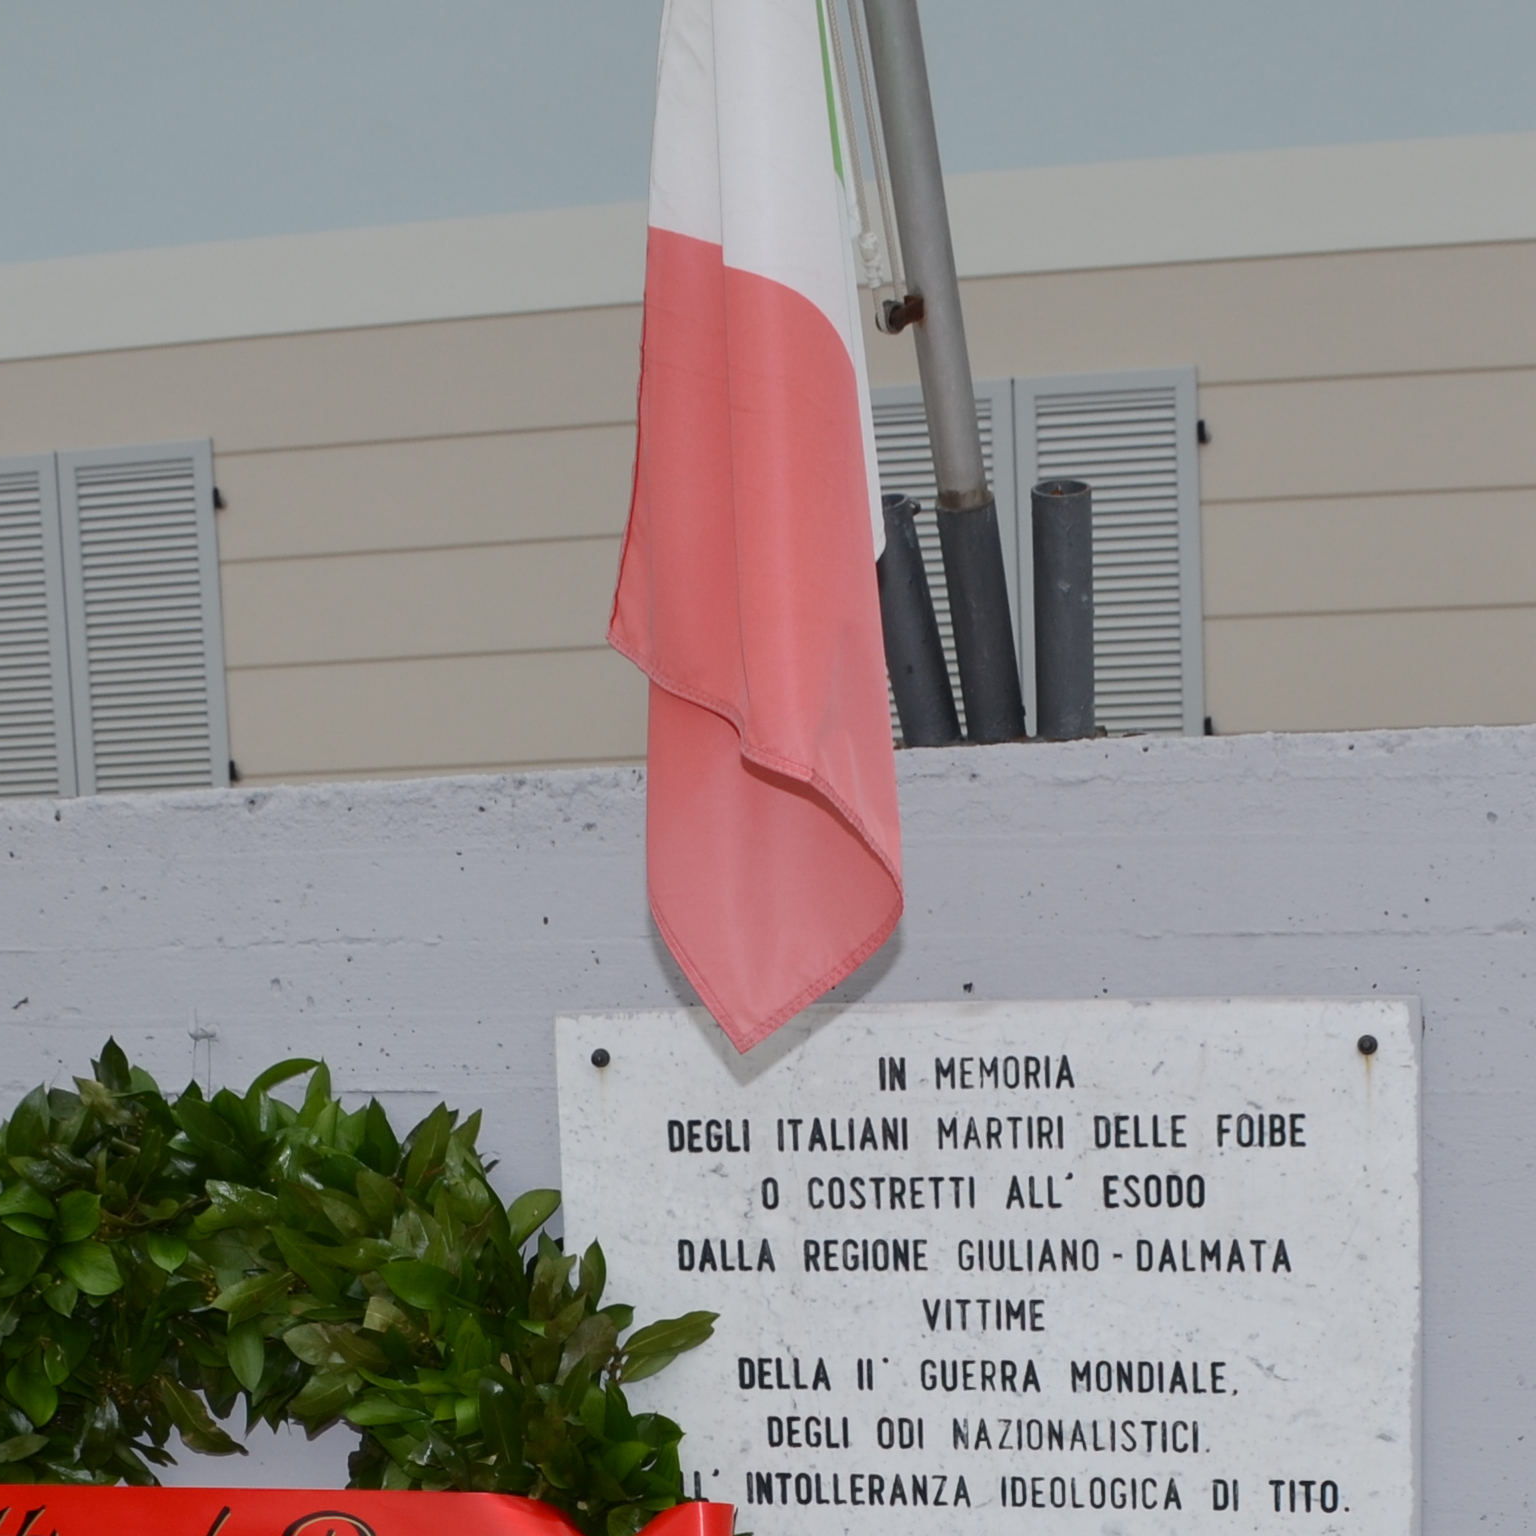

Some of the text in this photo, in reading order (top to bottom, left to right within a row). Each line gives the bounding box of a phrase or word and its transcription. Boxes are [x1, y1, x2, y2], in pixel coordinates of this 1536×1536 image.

[878, 1054, 1076, 1092] IN MEMORIA
[666, 1112, 1307, 1154] DEGLI ITALIANI MARTIRI DELLE FOIBE
[807, 1175, 976, 1211] COSTRETTI
[1102, 1173, 1206, 1210] ESODO
[677, 1237, 776, 1273] DALLA
[803, 1238, 929, 1273] REGIONE
[921, 1298, 1046, 1333] VITTIME
[737, 1356, 832, 1392] DELLA
[920, 1358, 1042, 1394] GUERRA
[1070, 1360, 1240, 1398] MONDIALE,
[766, 1415, 850, 1450] DEGLI
[876, 1416, 924, 1450] ODI
[745, 1471, 972, 1509] INTOLLERANZA
[1000, 1475, 1183, 1511] IDEOLOGICA
[1211, 1478, 1239, 1513] DI
[1268, 1479, 1352, 1514] TITO.
